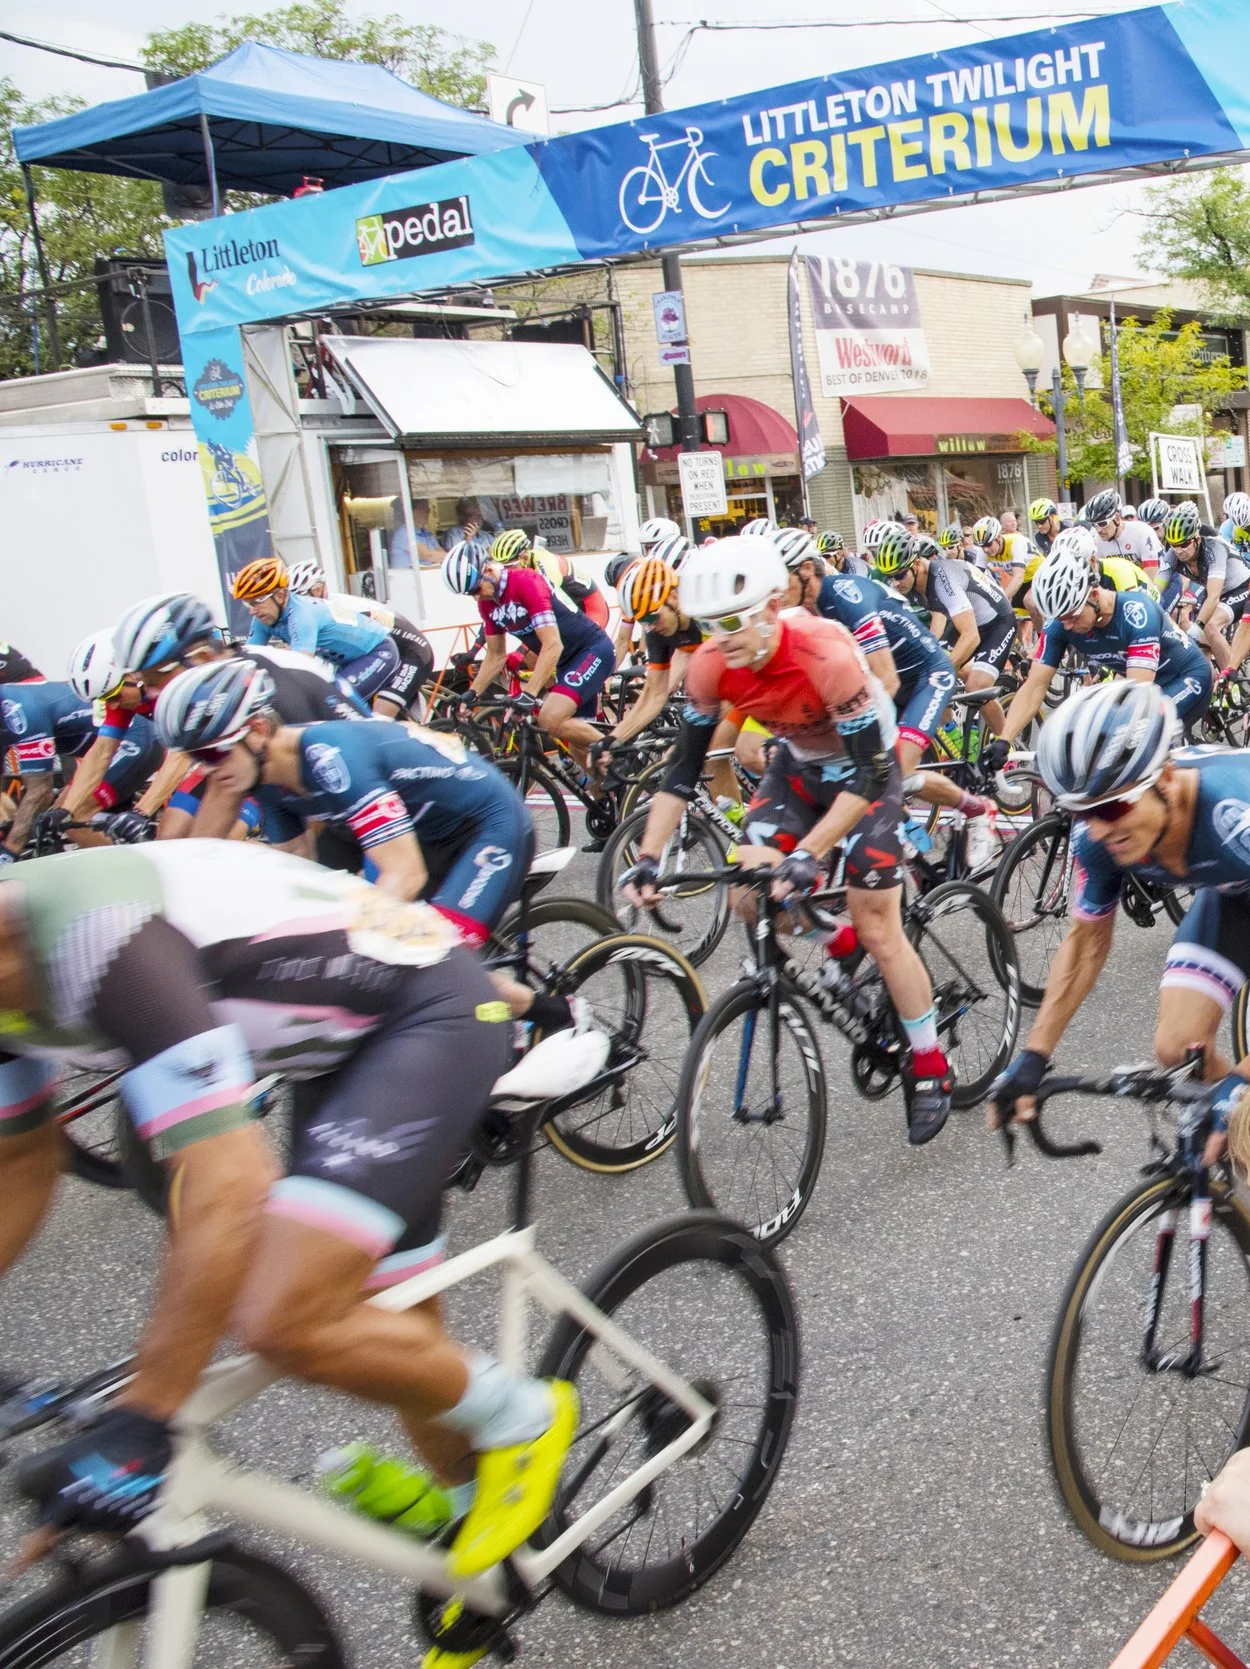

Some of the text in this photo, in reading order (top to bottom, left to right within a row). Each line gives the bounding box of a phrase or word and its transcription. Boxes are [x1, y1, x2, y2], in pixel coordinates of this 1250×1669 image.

[742, 41, 1106, 146] LITTLETON TWILIGHT
[749, 84, 1112, 208] CRITERIUM
[383, 196, 473, 261] pedal
[201, 238, 281, 273] Littleton
[246, 264, 296, 296] Colorado
[826, 374, 847, 386] BEST
[848, 372, 863, 384] OF
[938, 436, 986, 451] willow
[161, 449, 199, 462] color
[682, 457, 719, 467] NO TURNS
[1167, 445, 1193, 464] CROSS
[22, 457, 84, 469] HURRICANE
[997, 462, 1021, 479] 1876
[688, 469, 716, 480] ON RED
[1171, 466, 1194, 484] WALK
[693, 481, 714, 491] WHEN
[689, 501, 720, 511] PRESENT
